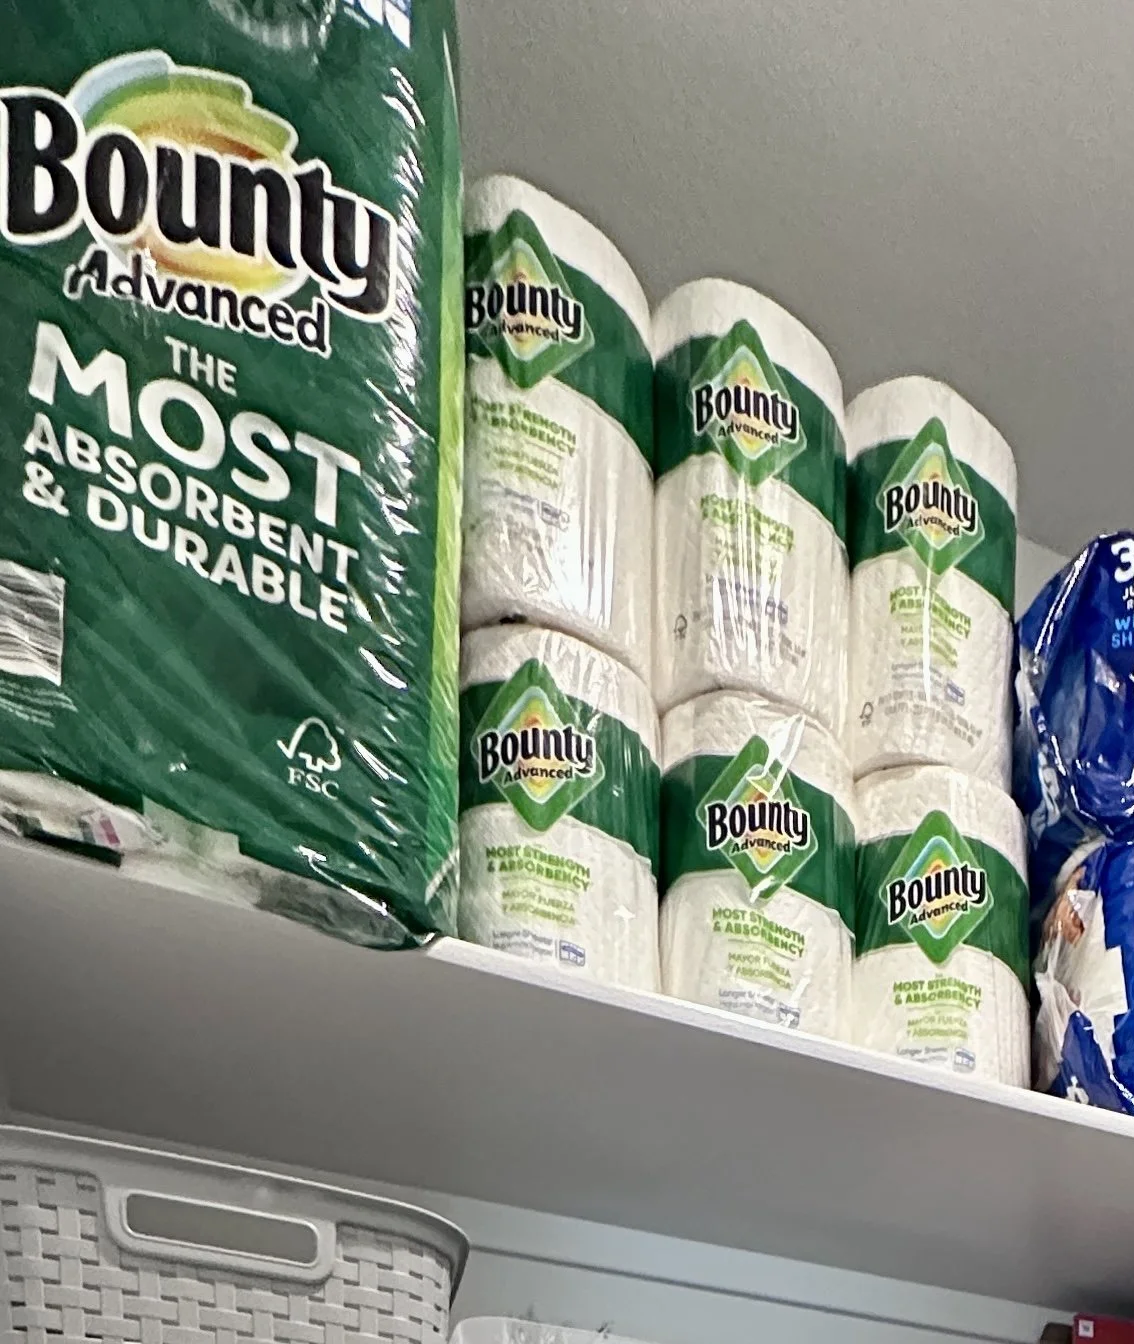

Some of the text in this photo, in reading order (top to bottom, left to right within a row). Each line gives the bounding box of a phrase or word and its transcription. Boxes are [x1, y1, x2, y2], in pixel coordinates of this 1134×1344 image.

[0, 94, 394, 317] Bounty
[70, 248, 328, 352] Advanced
[465, 281, 582, 339] Bounty
[164, 337, 238, 396] THE
[29, 320, 361, 528] MOST
[693, 384, 799, 438] Bounty
[717, 421, 779, 446] Advanced
[24, 412, 359, 584] ABSORBENT
[884, 482, 979, 532] Bounty
[905, 514, 961, 537] Advanced
[22, 460, 350, 633] & DURABLE
[479, 726, 595, 782] Bounty
[503, 764, 574, 785] Advanced
[286, 766, 341, 801] FSC
[707, 800, 812, 850] Bounty
[730, 834, 792, 856] Advanced
[887, 864, 989, 927] Bounty
[910, 900, 970, 927] Advanced
